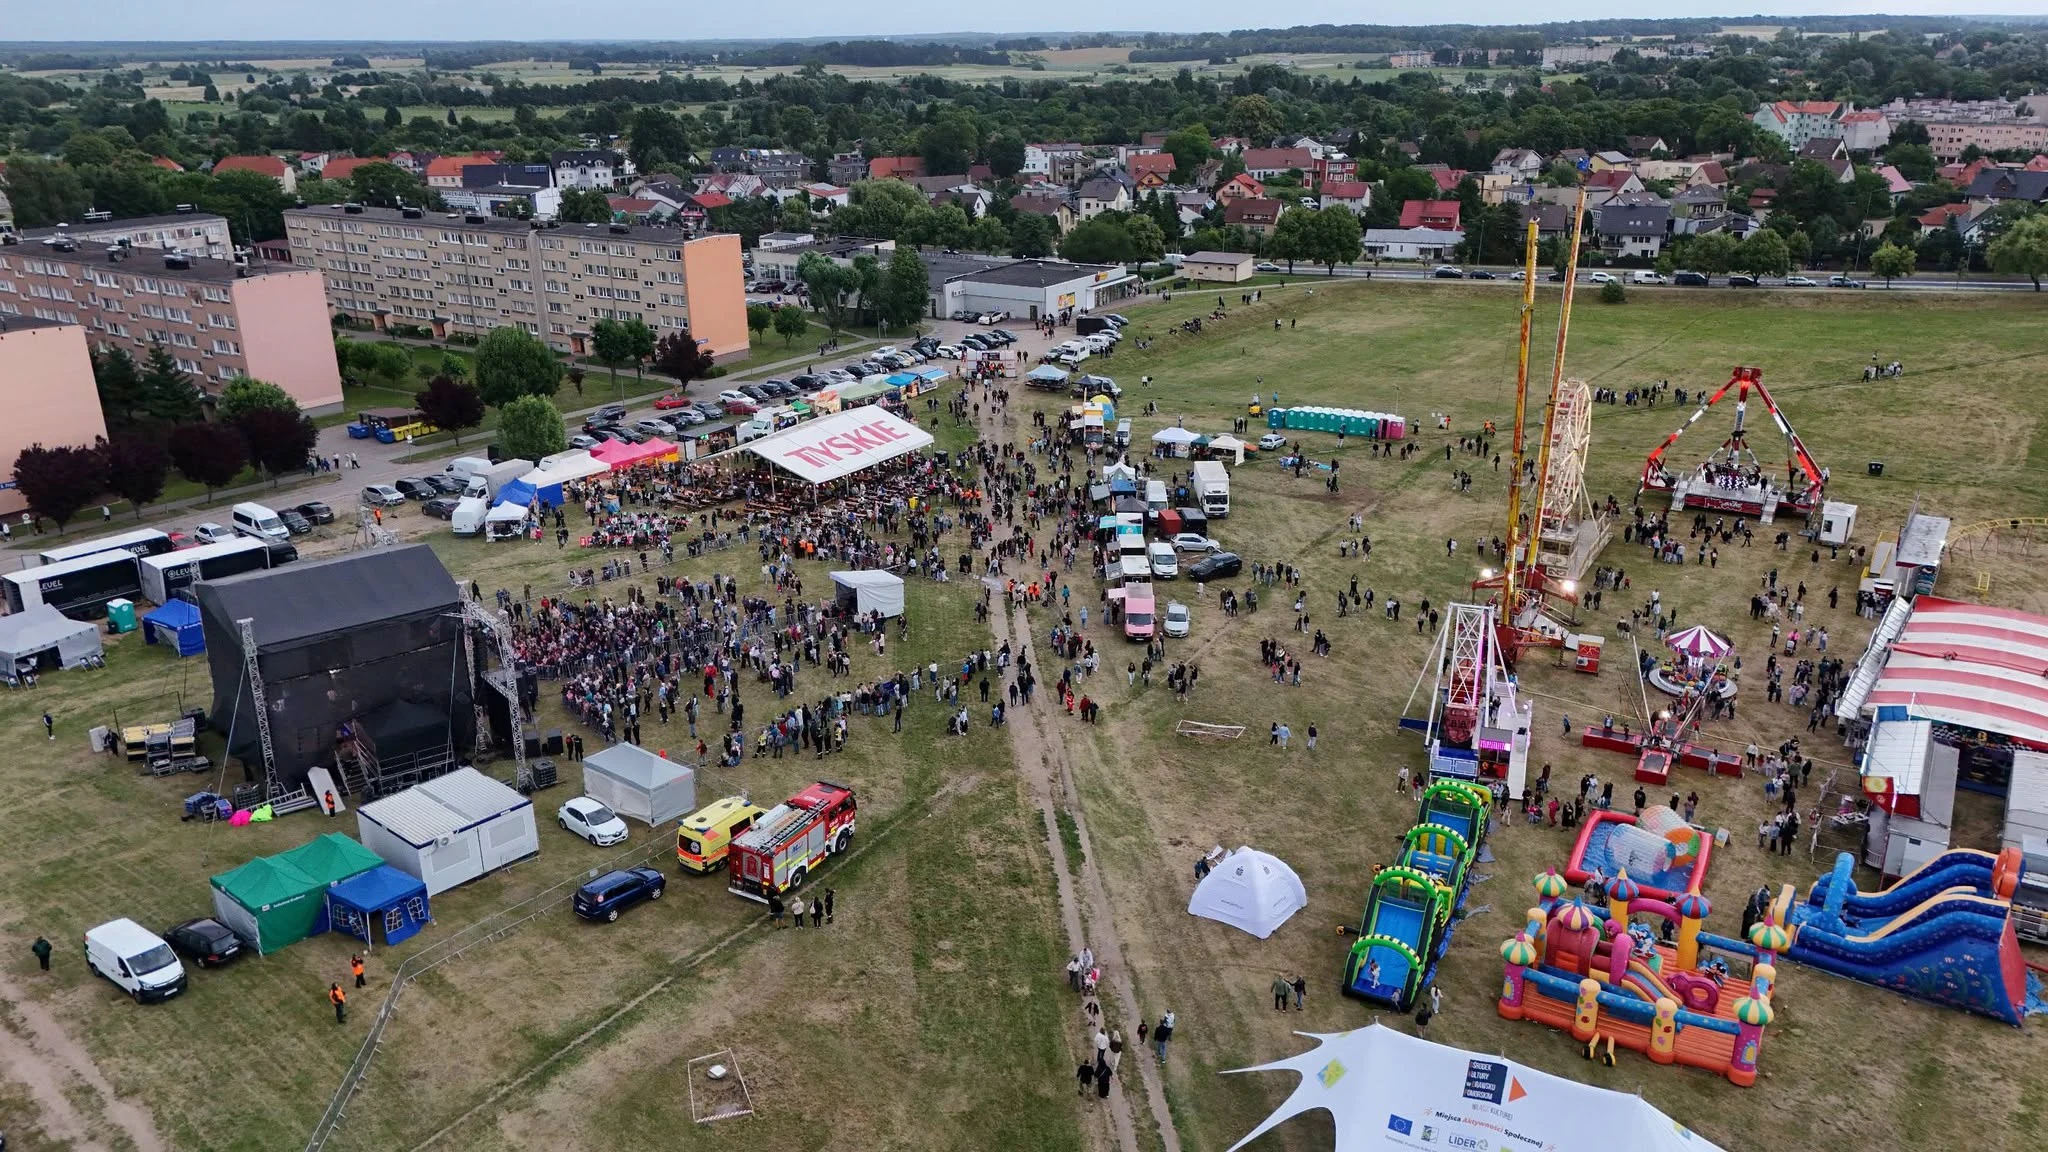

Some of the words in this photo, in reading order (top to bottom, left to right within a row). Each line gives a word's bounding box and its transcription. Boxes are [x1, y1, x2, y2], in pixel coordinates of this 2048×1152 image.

[783, 419, 910, 468] TYSKIE
[1435, 1111, 1461, 1122] Miejsca
[1462, 1117, 1504, 1133] Aktywności
[1504, 1128, 1543, 1148] Społecznej
[1448, 1135, 1477, 1149] LIDER
